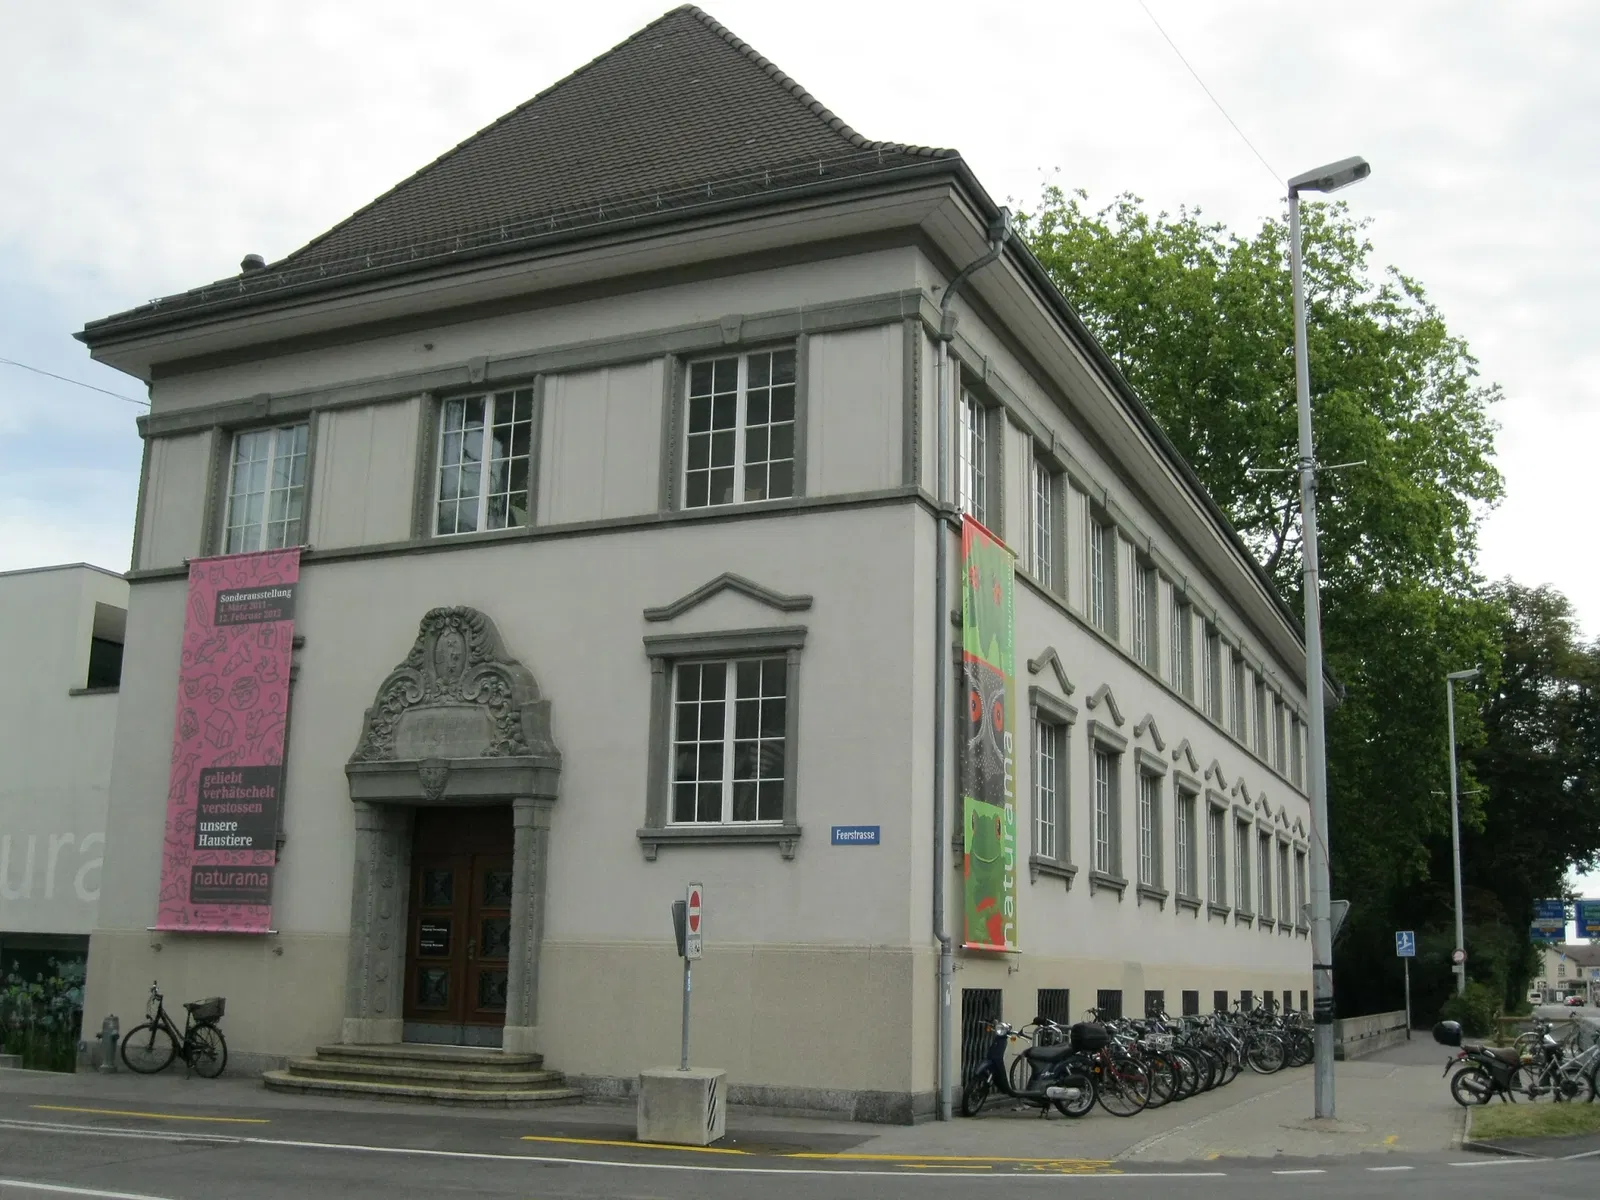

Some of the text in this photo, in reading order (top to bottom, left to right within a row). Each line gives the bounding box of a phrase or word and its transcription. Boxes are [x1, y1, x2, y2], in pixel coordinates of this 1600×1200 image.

[220, 588, 292, 603] Sonderausstellung
[231, 611, 263, 622] Februar
[203, 772, 243, 788] geliebt
[203, 786, 275, 799] verhätschelt
[202, 802, 263, 814] verstossen
[200, 821, 238, 832] unsere
[198, 834, 253, 846] Haustiere
[836, 829, 875, 840] Feerstrasse
[1003, 732, 1014, 949] naturama
[194, 871, 269, 886] naturama
